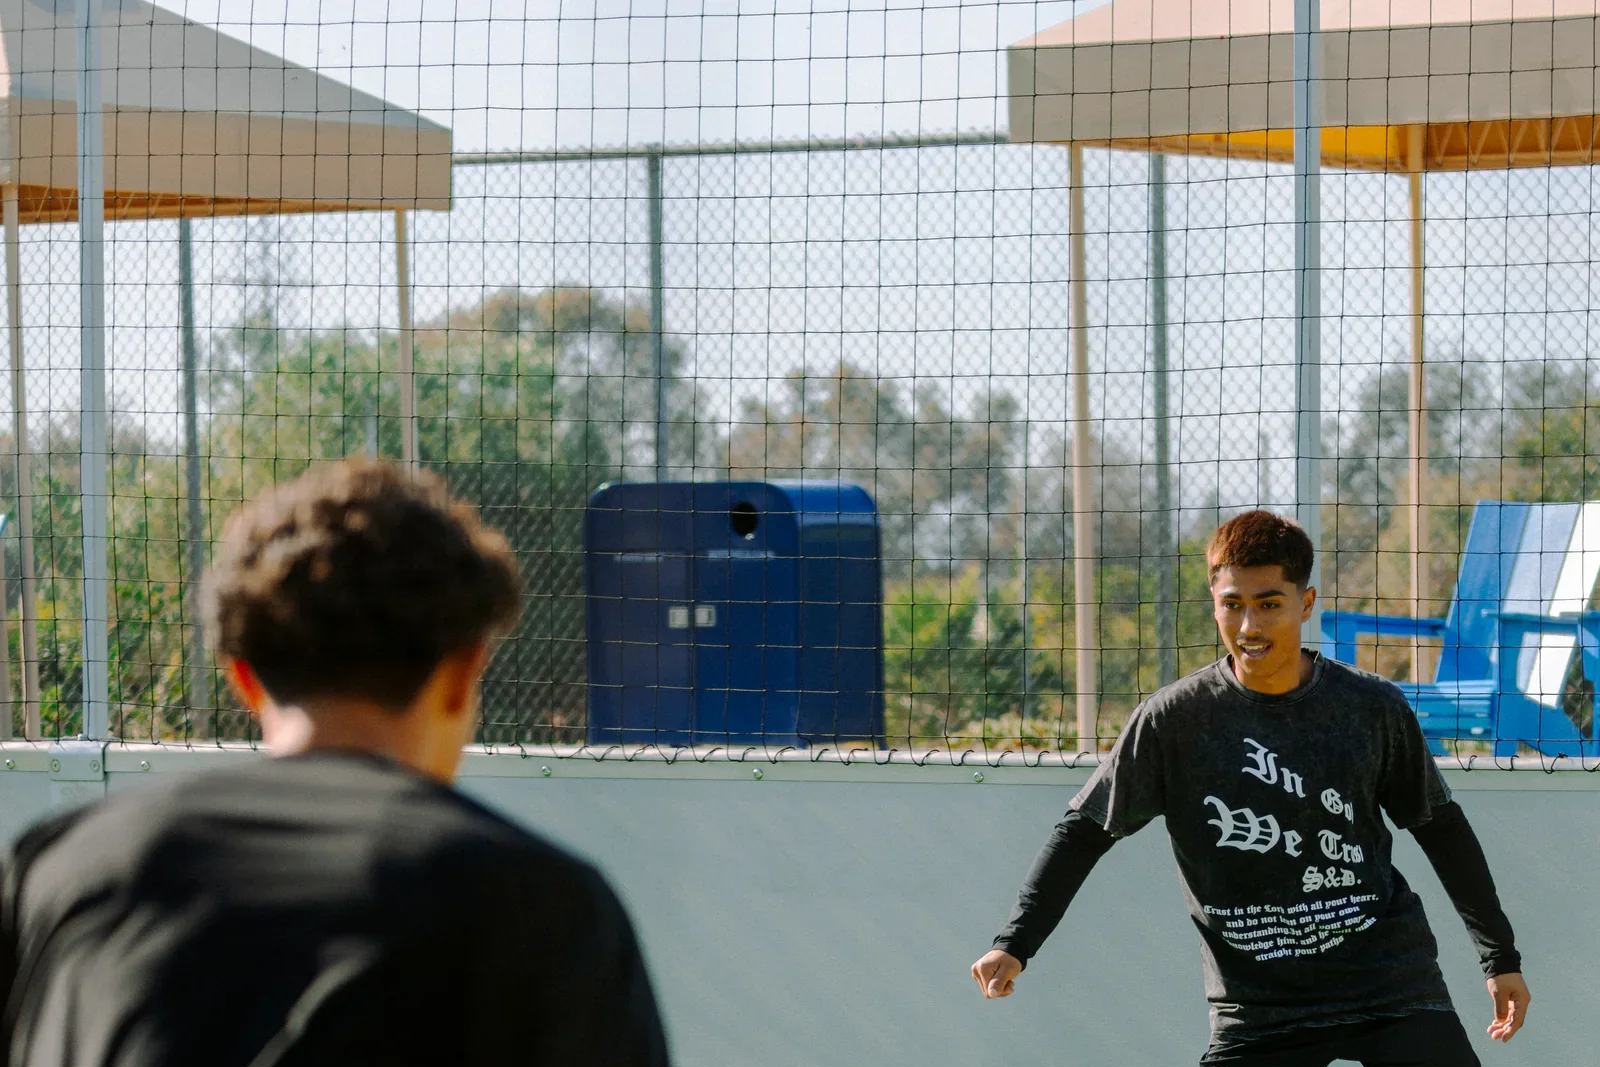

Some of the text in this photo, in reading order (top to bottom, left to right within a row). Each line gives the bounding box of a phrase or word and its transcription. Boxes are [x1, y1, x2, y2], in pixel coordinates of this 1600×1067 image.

[1241, 738, 1354, 825] In Go
[1203, 795, 1303, 858] We
[1203, 905, 1231, 916] Trust
[1234, 907, 1244, 916] in
[1247, 905, 1262, 915] the
[1287, 903, 1308, 914] with
[1310, 901, 1323, 911] all
[1325, 897, 1347, 909] your
[1226, 919, 1244, 928] and
[1247, 918, 1258, 928] do
[1261, 916, 1277, 924] not
[1299, 915, 1312, 924] on
[1314, 912, 1336, 922] your
[1338, 906, 1360, 916] own
[1304, 923, 1316, 933] all
[1300, 934, 1318, 946] and
[1318, 930, 1329, 940] he
[1255, 948, 1293, 962] straight
[1294, 947, 1317, 957] your
